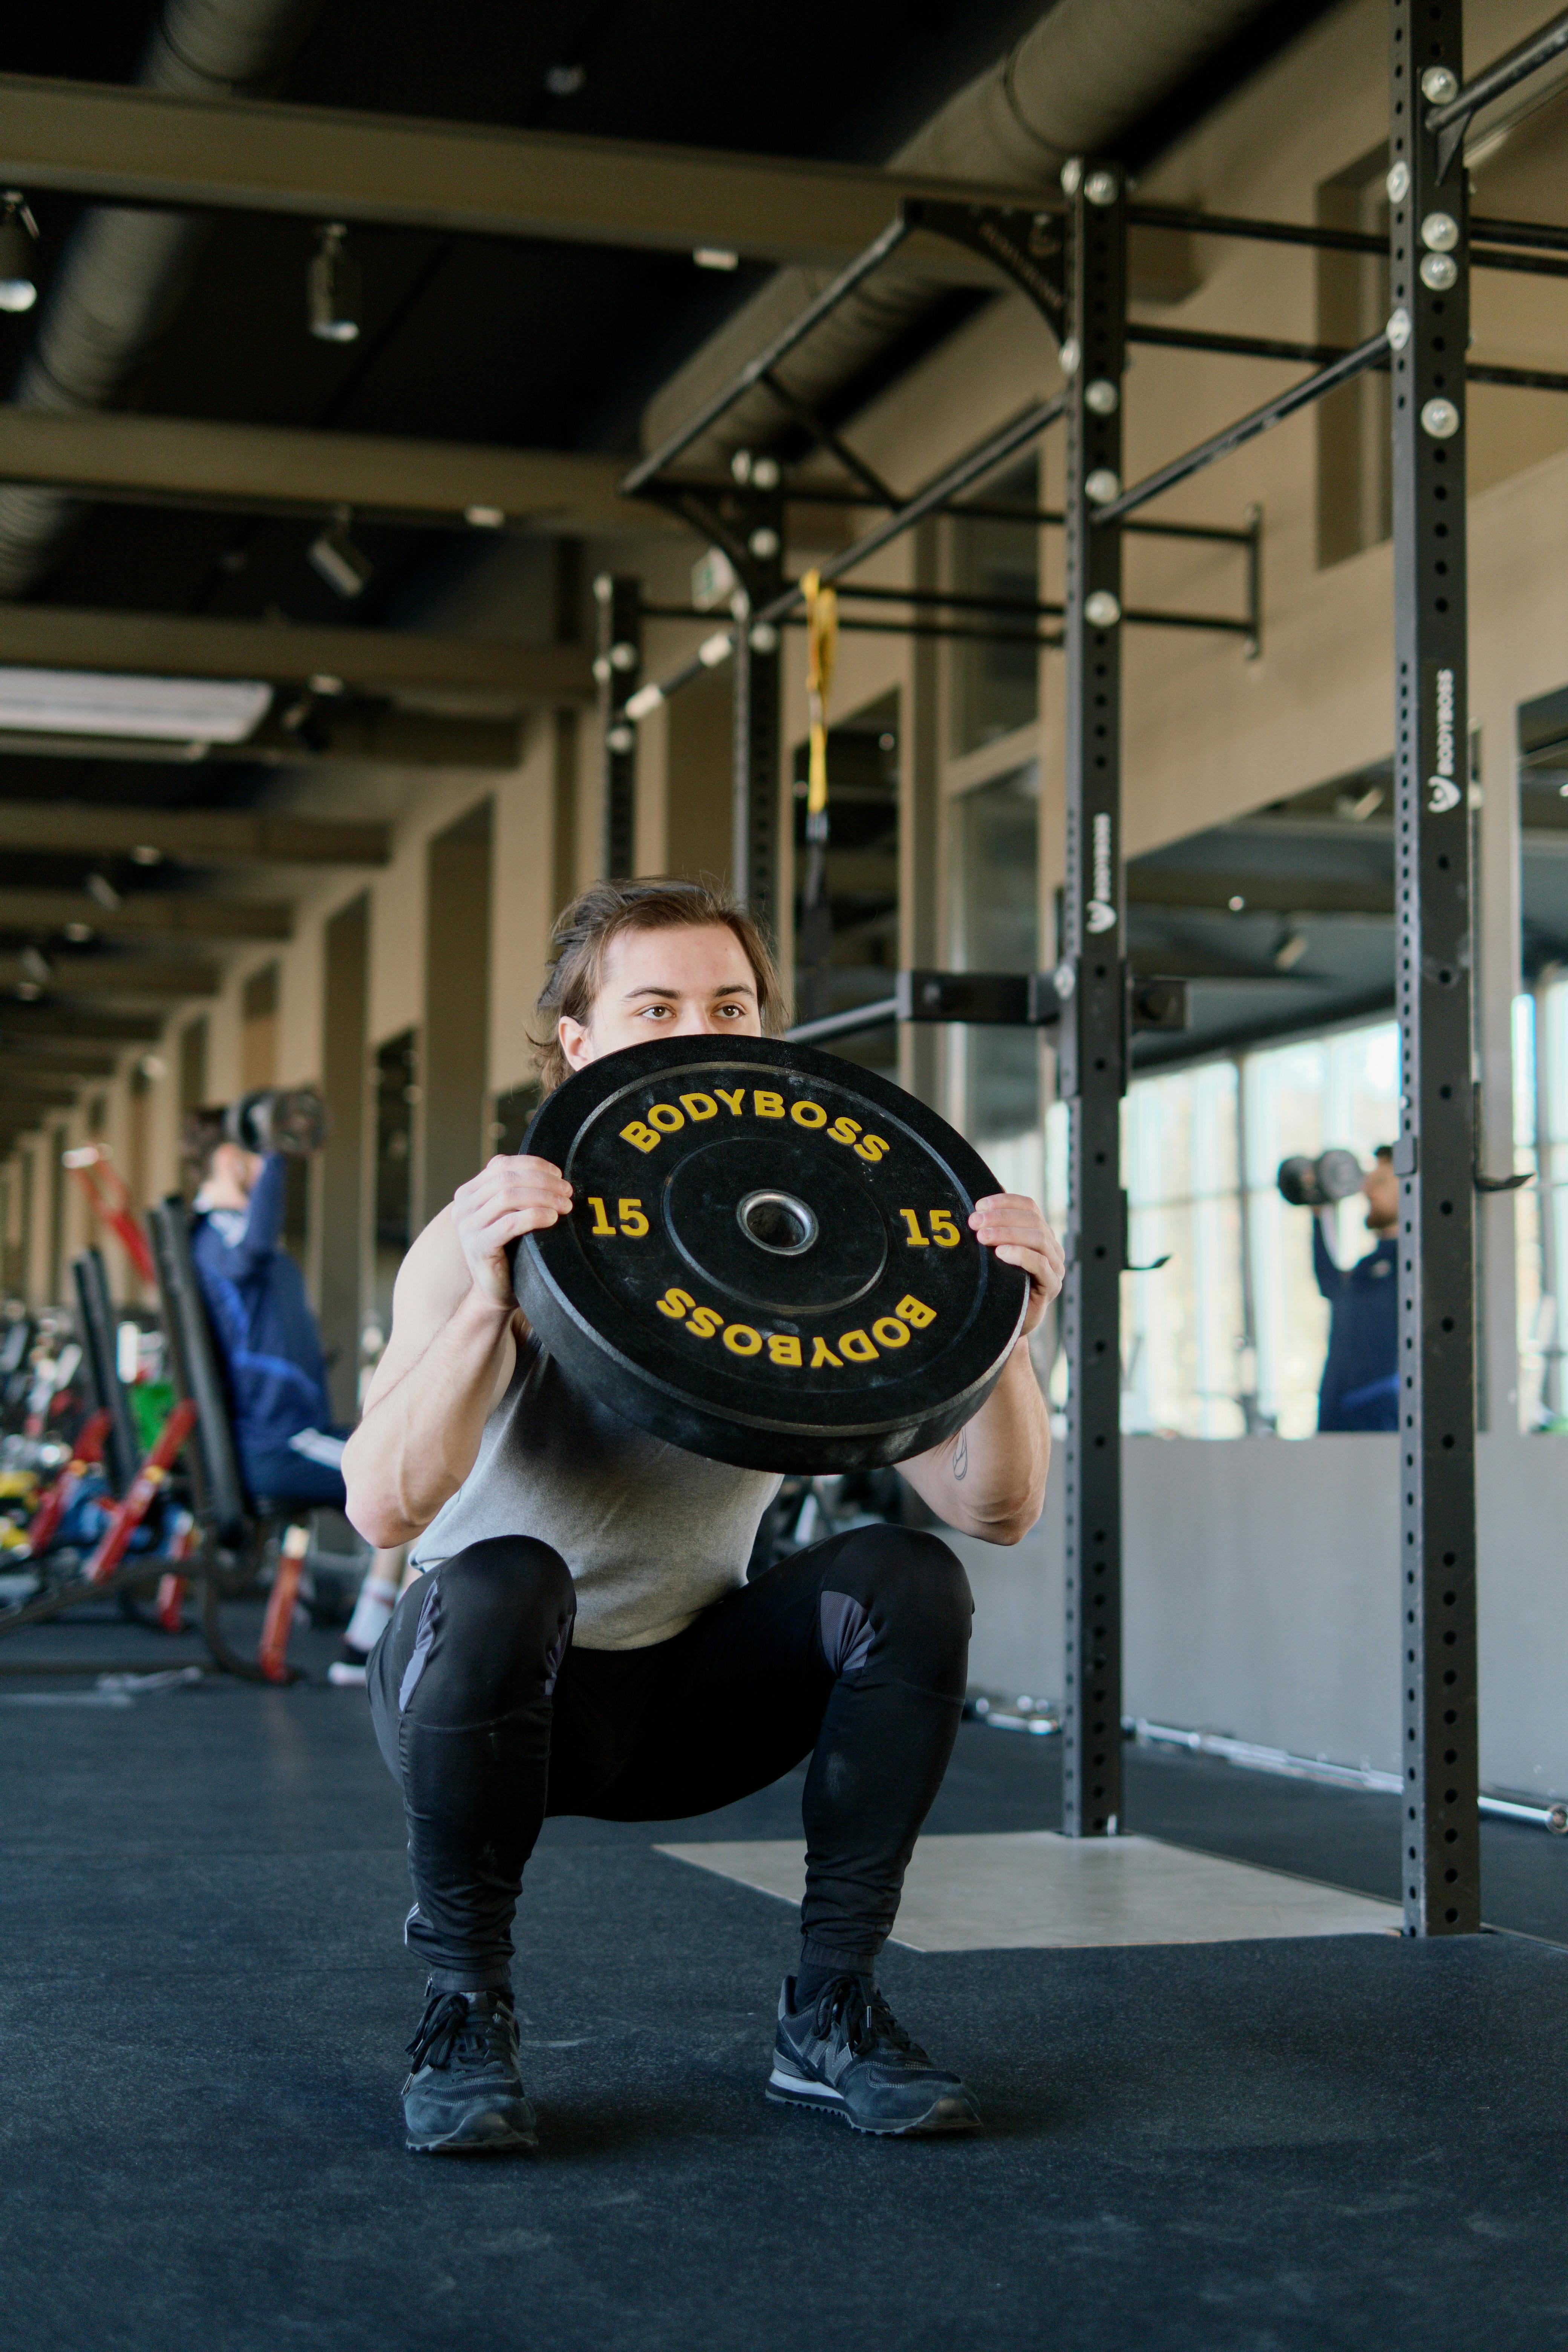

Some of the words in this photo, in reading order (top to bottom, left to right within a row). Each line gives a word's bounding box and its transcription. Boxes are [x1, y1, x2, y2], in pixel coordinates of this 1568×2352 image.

[620, 1089, 890, 1162] BODYBOSS
[588, 1197, 649, 1237] 15
[900, 1208, 961, 1247] 15
[657, 1288, 937, 1367] BODYBOSS
